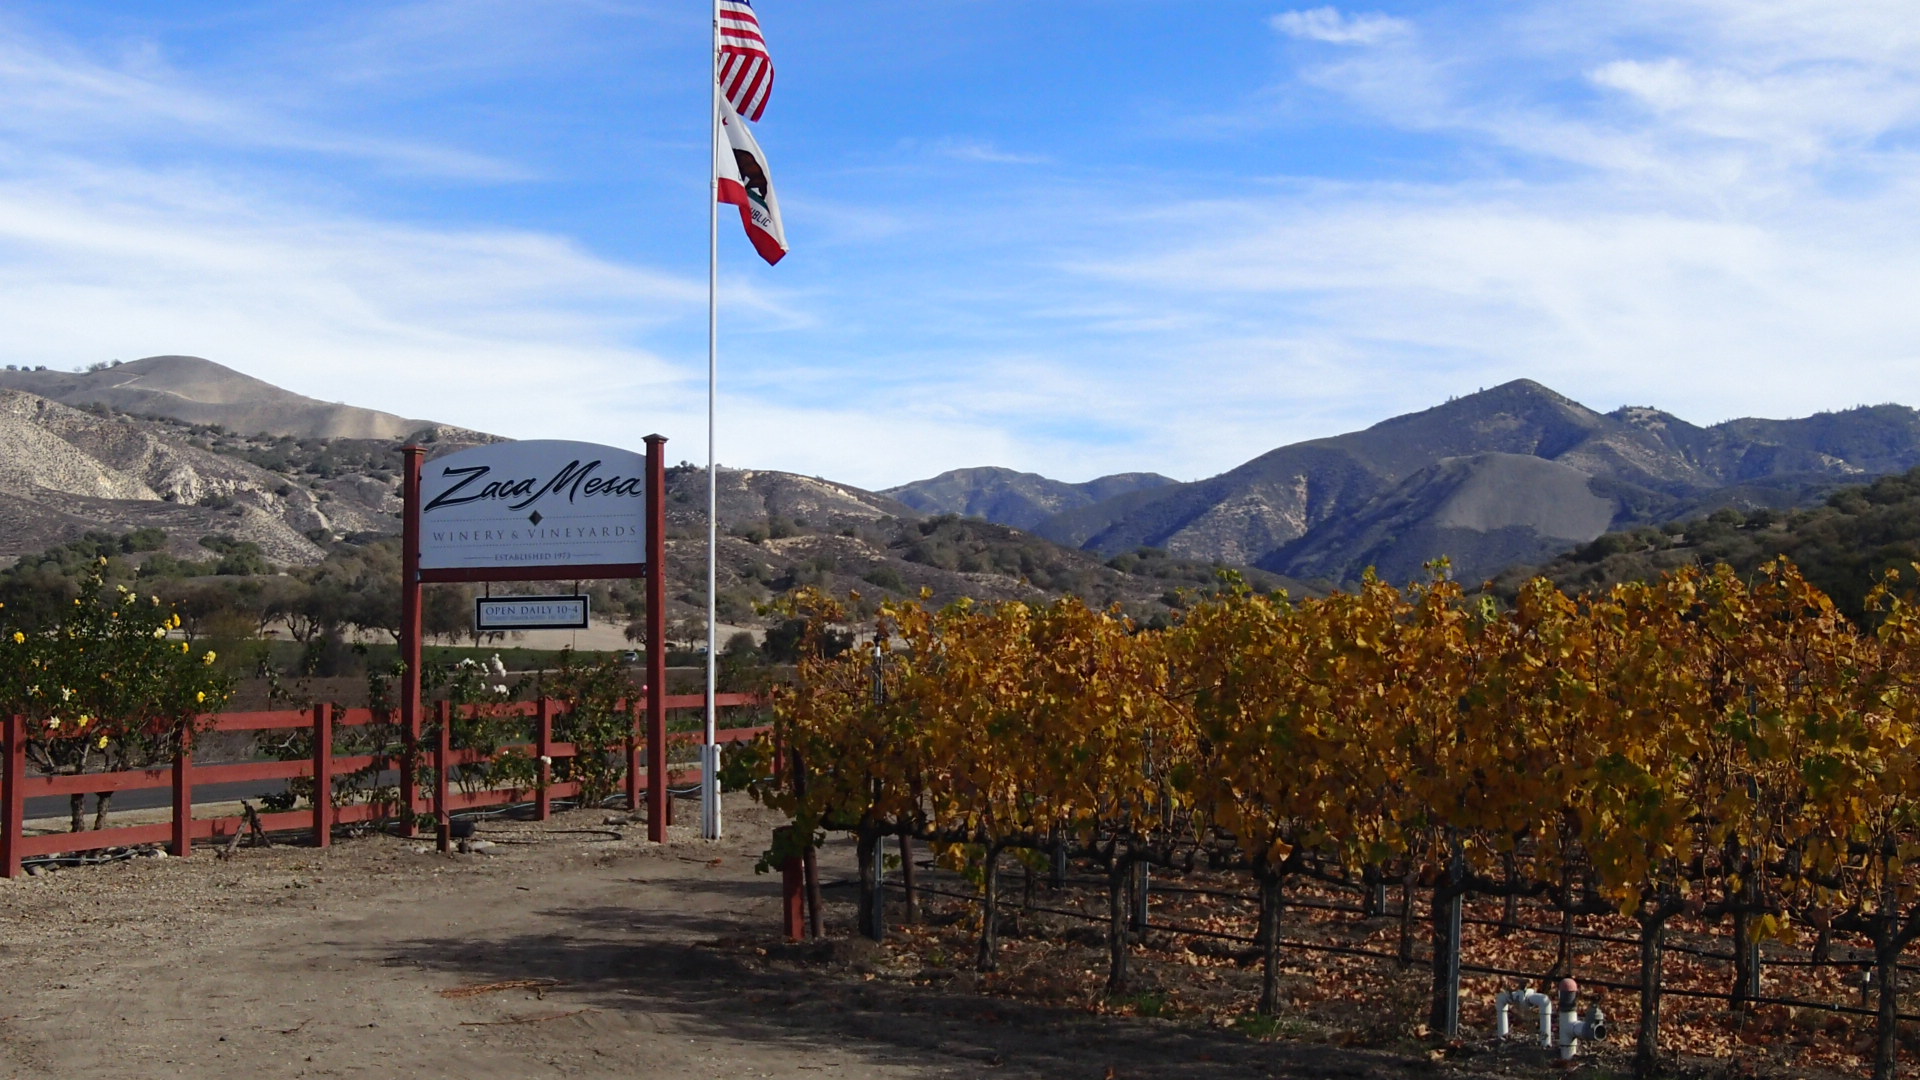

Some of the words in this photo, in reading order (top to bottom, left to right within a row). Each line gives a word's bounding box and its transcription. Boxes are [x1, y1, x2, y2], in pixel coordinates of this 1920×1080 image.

[423, 465, 538, 513] Zaca
[508, 459, 643, 512] Mesa
[432, 529, 505, 542] WINERY
[511, 529, 520, 540] &
[527, 525, 637, 540] VINEYARDS
[494, 552, 552, 561] ESTABLISHED
[485, 606, 516, 616] OPEN
[520, 605, 553, 615] DAILY
[557, 604, 579, 615] 10-4
